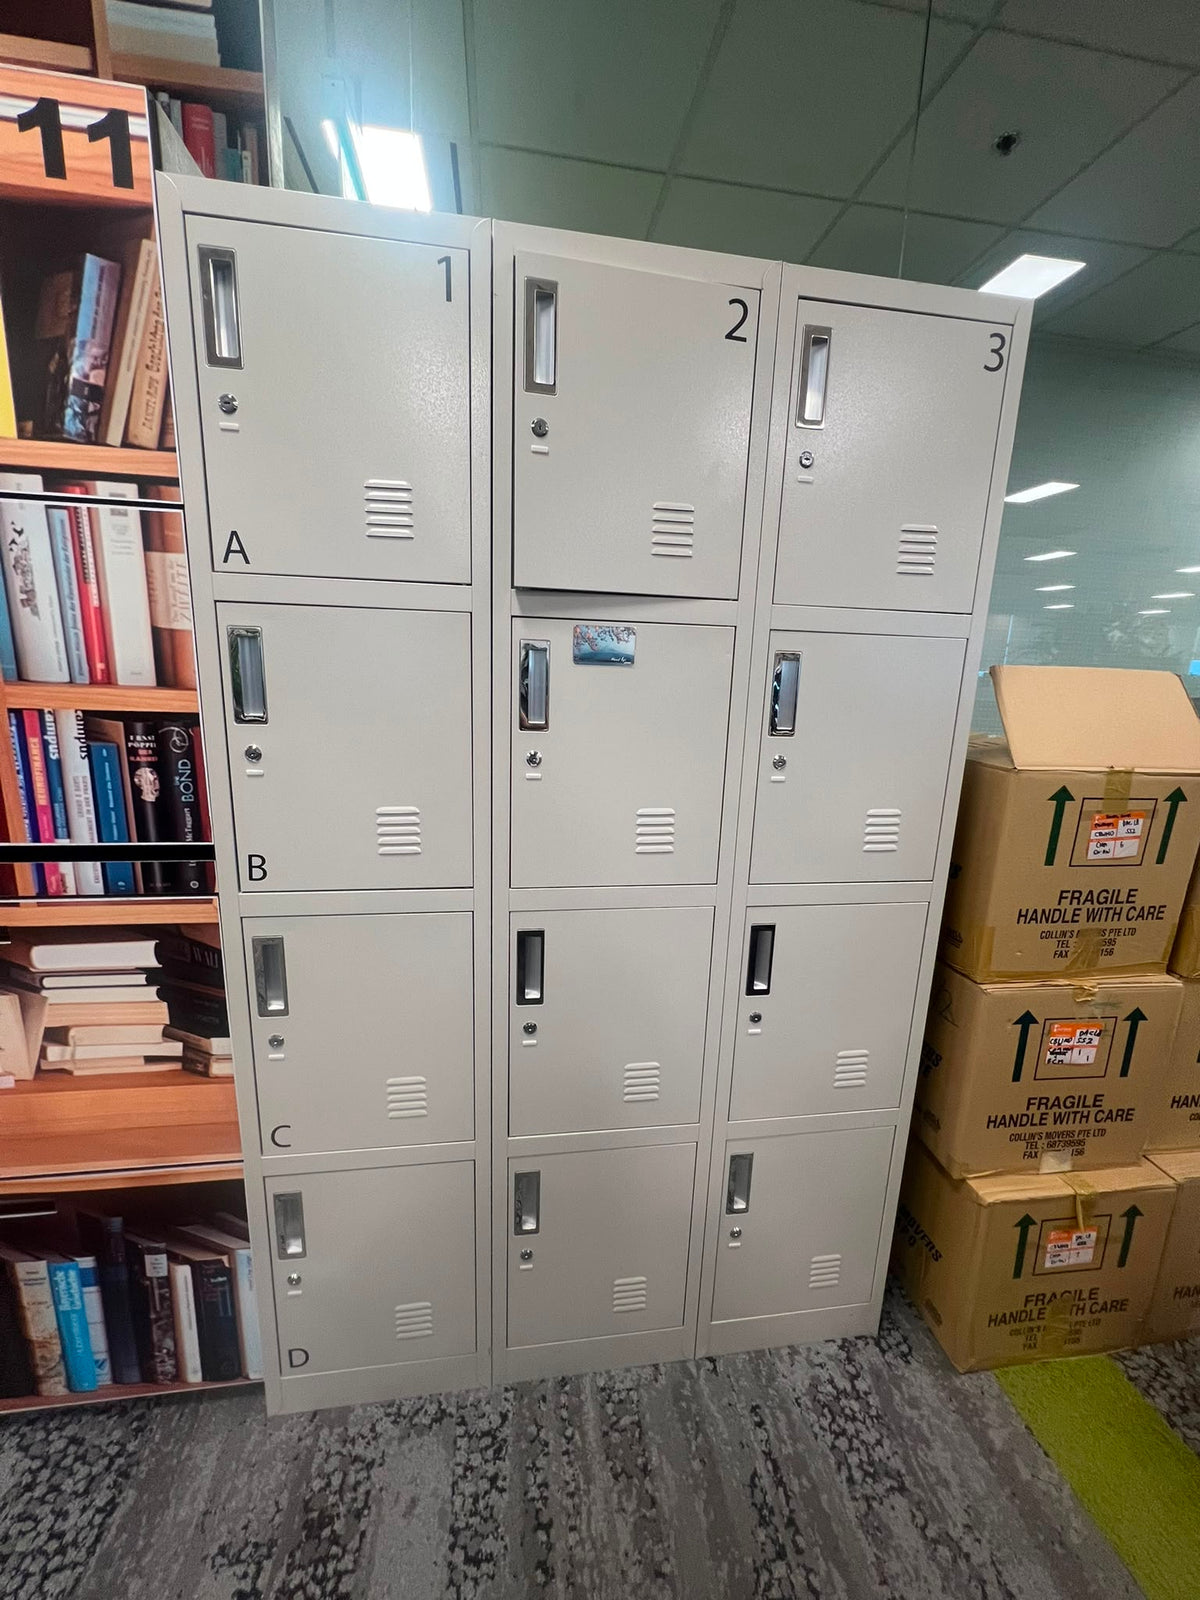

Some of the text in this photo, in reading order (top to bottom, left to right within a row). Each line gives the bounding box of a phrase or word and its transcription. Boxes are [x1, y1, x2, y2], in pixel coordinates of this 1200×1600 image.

[18, 97, 134, 190] 11
[437, 255, 452, 302] 1
[724, 298, 749, 343] 2
[983, 332, 1006, 372] 3
[223, 530, 251, 565] A
[42, 708, 59, 760] campus
[178, 758, 194, 802] BOND
[247, 853, 268, 882] B
[1057, 888, 1138, 906] FRAGILE
[1016, 905, 1167, 924] HANDLE WITH CARE
[1040, 929, 1075, 940] COLLIN'S
[1108, 928, 1122, 937] PTE
[1123, 927, 1136, 937] LTD
[1056, 939, 1070, 949] TEL
[1053, 949, 1069, 959] FAX
[1026, 1094, 1104, 1111] FRAGILE
[1170, 1095, 1200, 1109] HAN
[986, 1108, 1135, 1129] HANDLE WITH CARE
[270, 1124, 292, 1148] C
[1009, 1128, 1107, 1142] COLLIN'S MOVERS PTE LTD
[1025, 1141, 1039, 1150] TEL
[1023, 1151, 1039, 1160] FAX
[988, 1307, 1046, 1328] HANDLE
[1089, 1298, 1129, 1315] CARE
[287, 1347, 310, 1369] D
